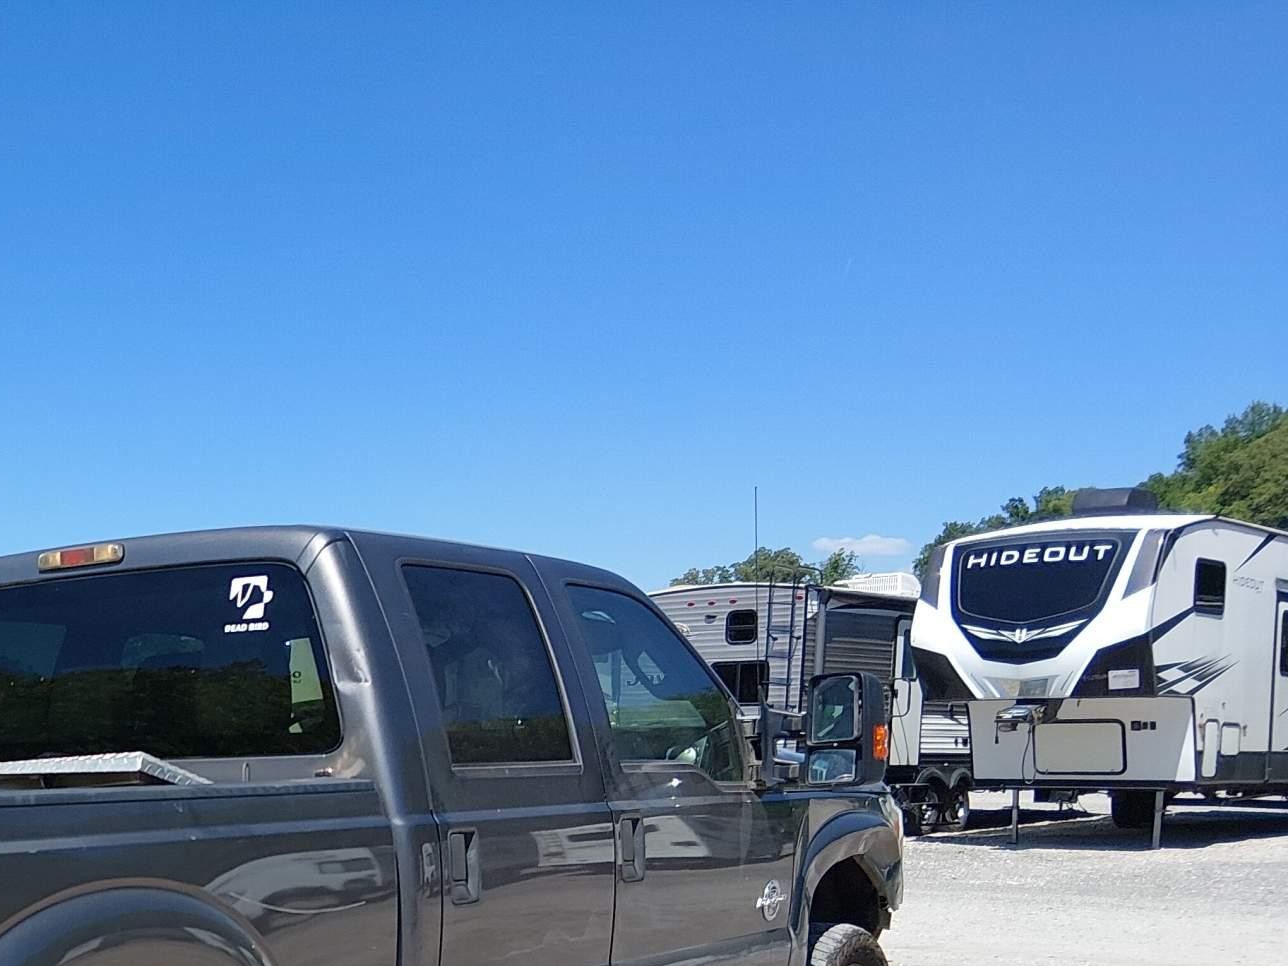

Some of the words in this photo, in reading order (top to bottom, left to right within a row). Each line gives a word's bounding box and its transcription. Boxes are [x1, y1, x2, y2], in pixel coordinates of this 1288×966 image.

[966, 545, 1113, 569] HIDEOUT
[224, 623, 248, 633] DEAD
[248, 621, 270, 632] BIRD
